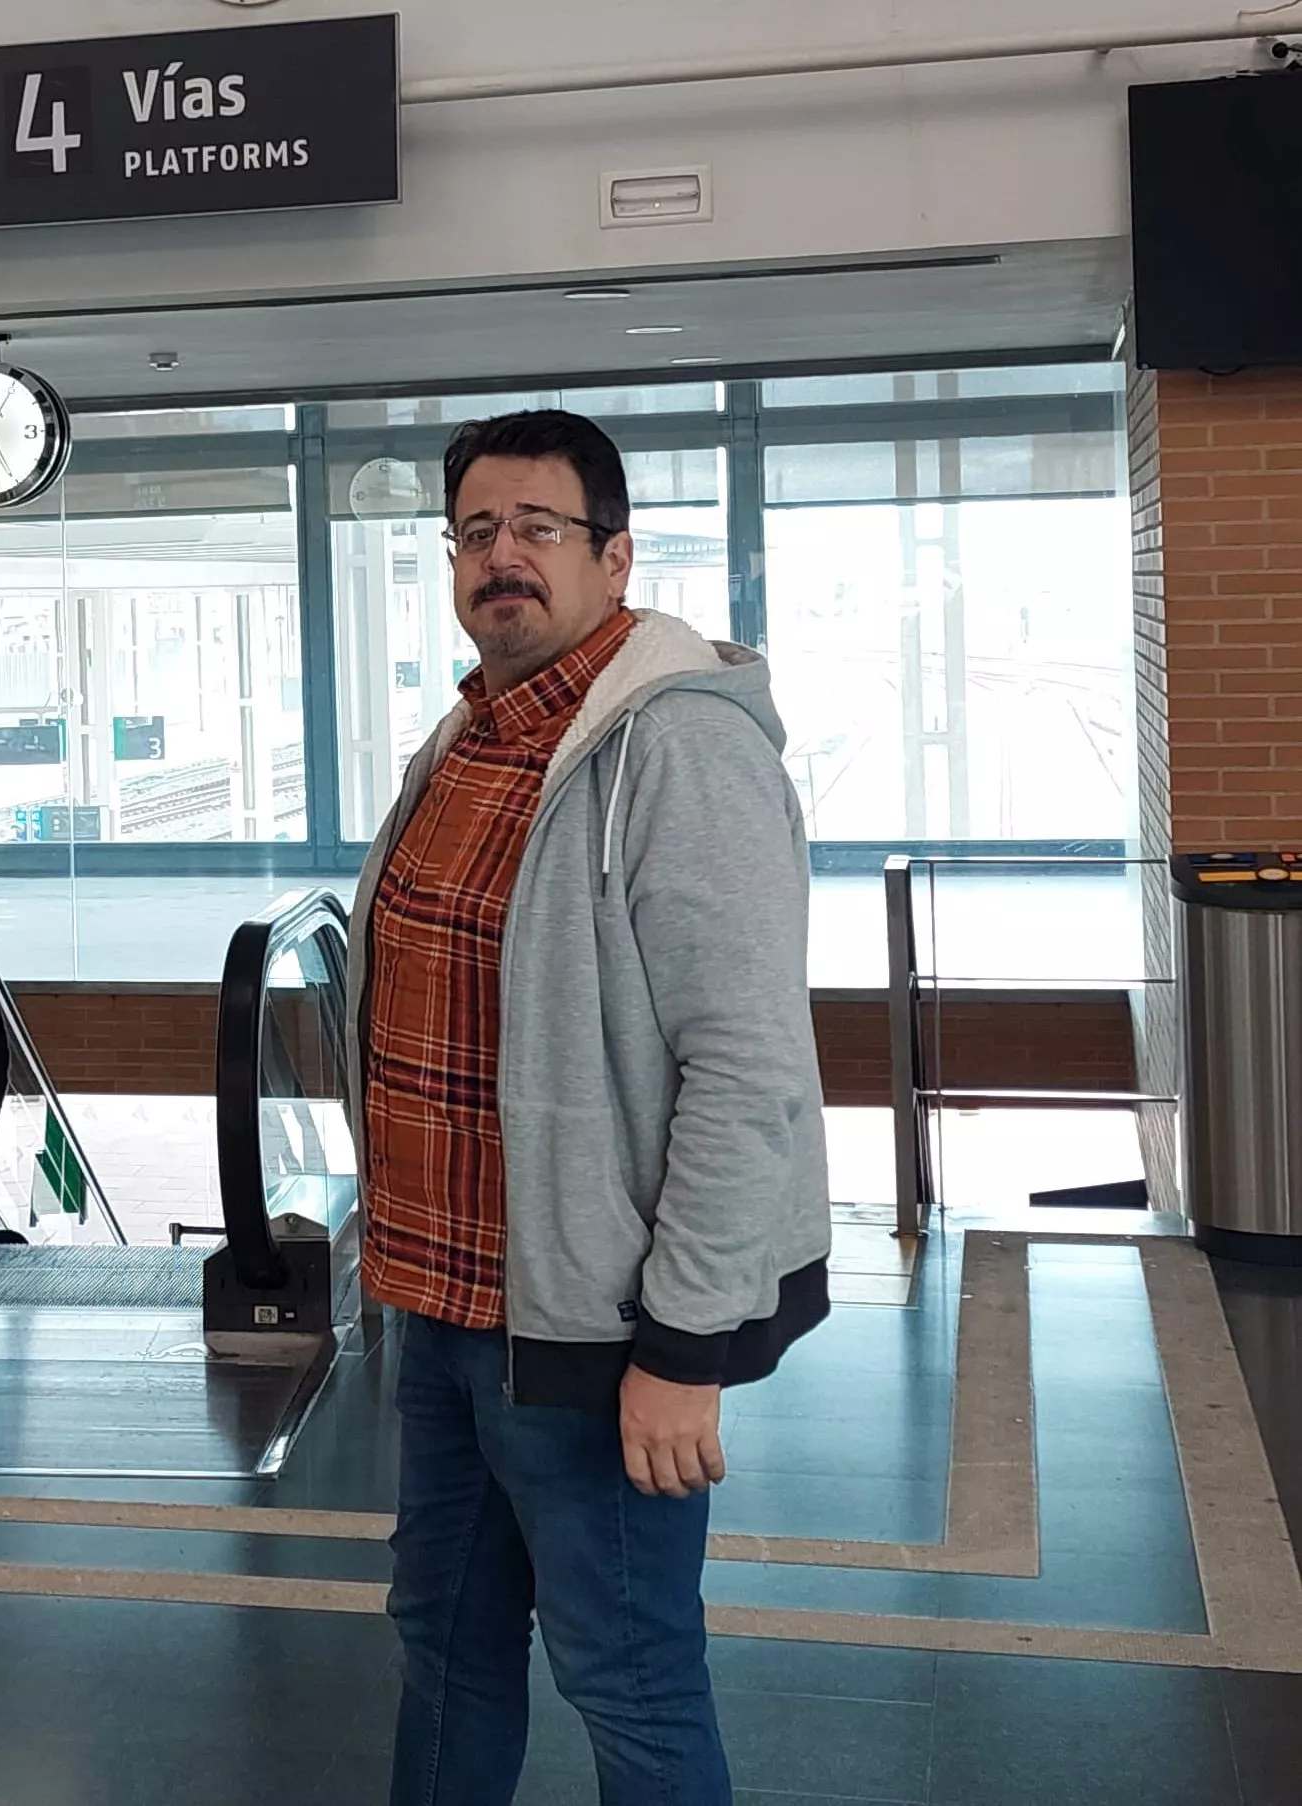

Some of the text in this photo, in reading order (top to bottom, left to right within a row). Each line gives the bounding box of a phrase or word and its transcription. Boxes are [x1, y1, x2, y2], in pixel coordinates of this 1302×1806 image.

[123, 62, 247, 124] Vías
[14, 73, 82, 174] 4
[124, 138, 310, 178] PLATFORMS
[24, 424, 38, 440] 3
[149, 737, 162, 759] 3
